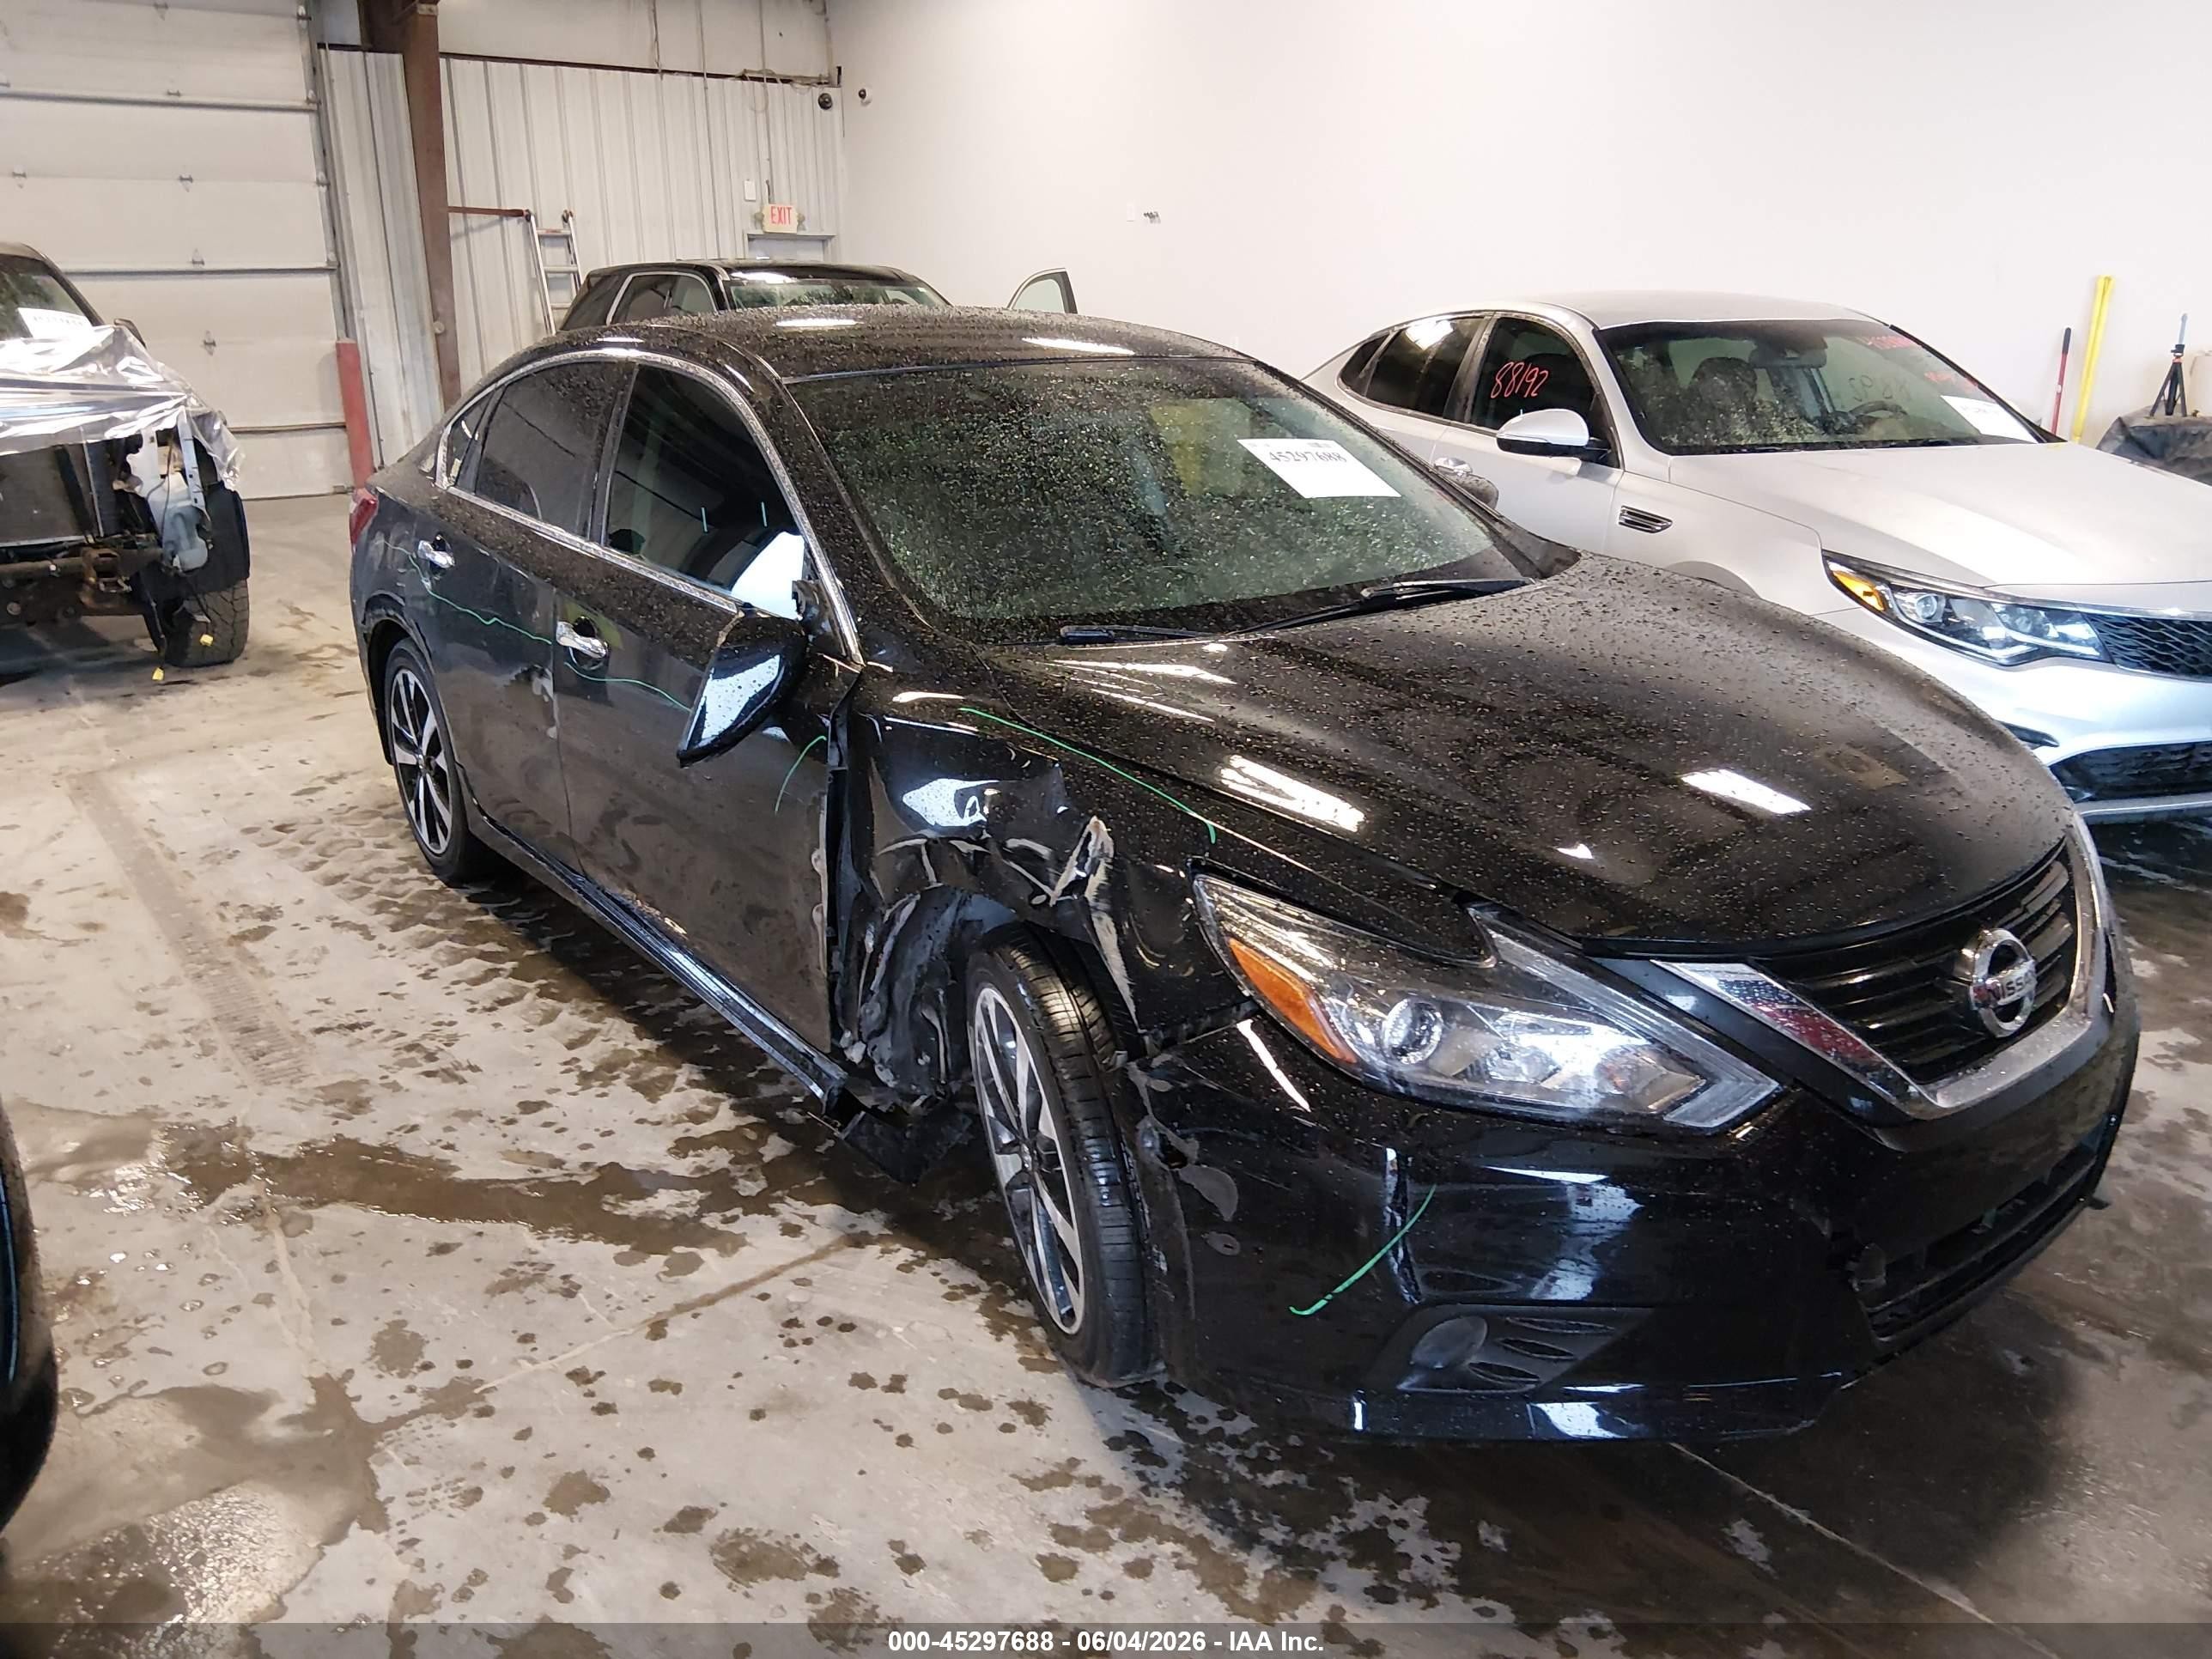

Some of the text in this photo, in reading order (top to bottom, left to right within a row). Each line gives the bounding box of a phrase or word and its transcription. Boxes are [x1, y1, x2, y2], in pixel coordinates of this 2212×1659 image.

[770, 205, 793, 225] EXIT
[1269, 451, 1347, 463] 45297688
[1985, 969, 2036, 1002] NISSA
